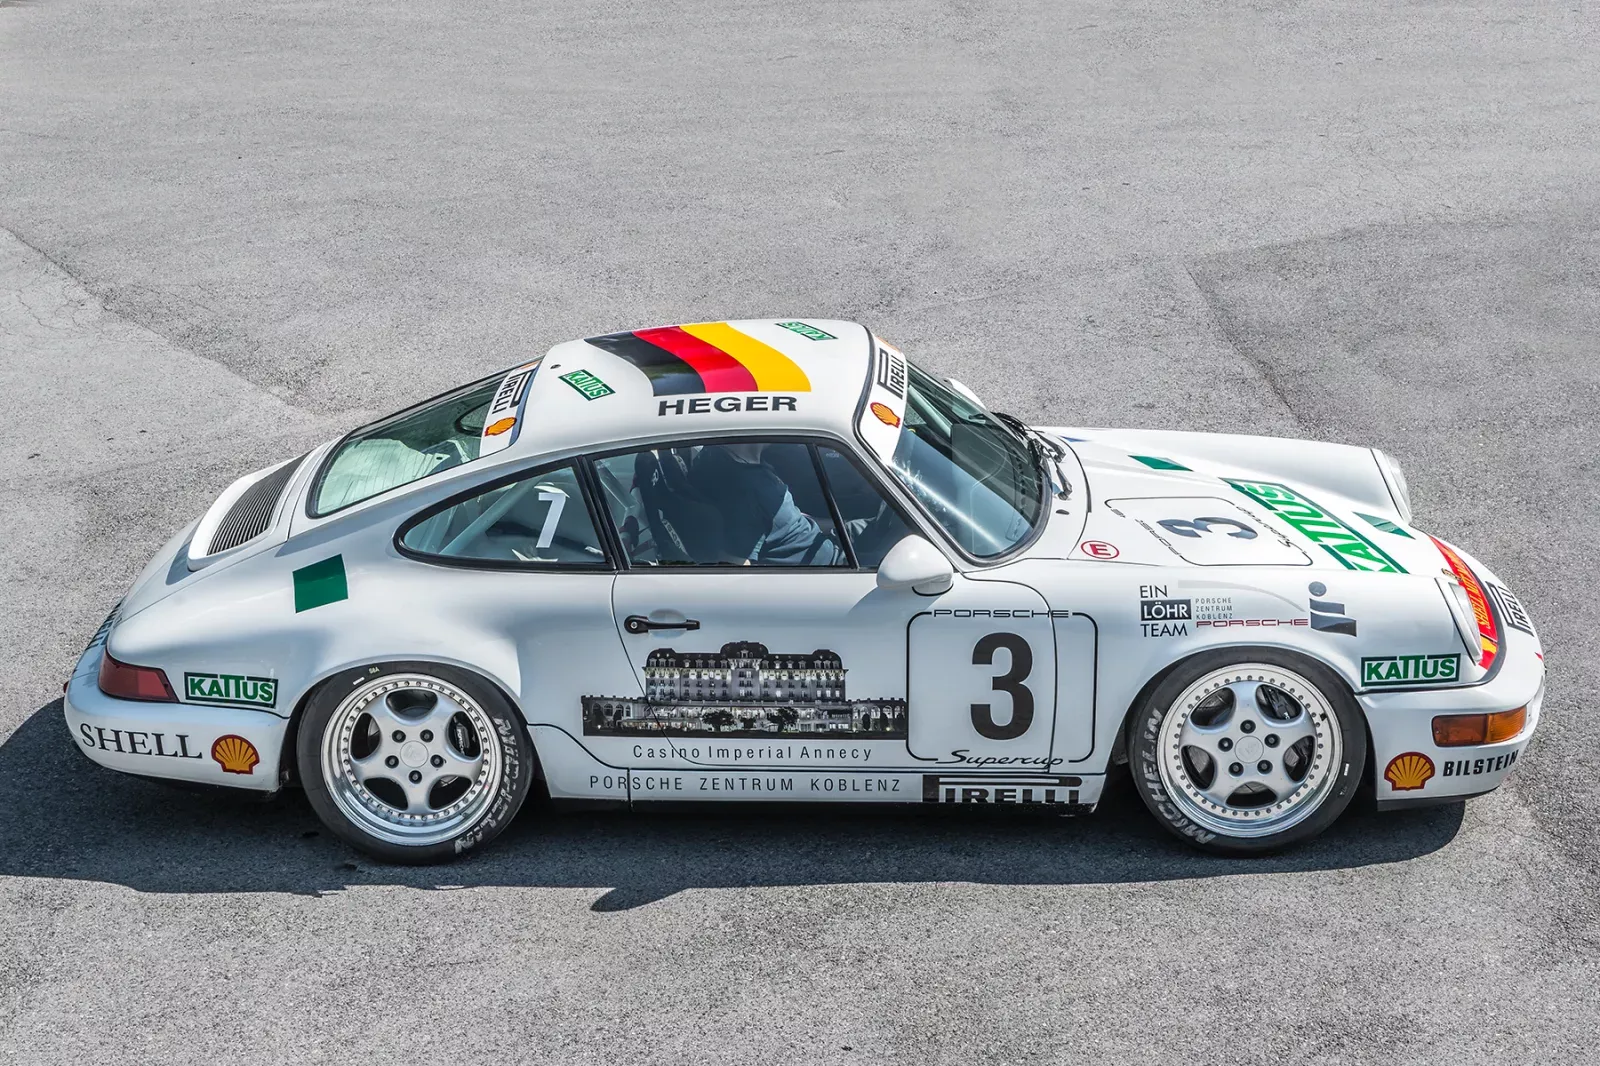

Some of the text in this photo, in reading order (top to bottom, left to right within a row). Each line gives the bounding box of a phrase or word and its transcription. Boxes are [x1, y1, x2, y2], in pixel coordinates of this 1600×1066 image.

[562, 371, 610, 398] KATTUS
[877, 347, 905, 400] PIRELLI
[491, 368, 536, 414] PIRELLI
[658, 396, 798, 417] HEGER
[1156, 516, 1258, 540] 3
[1088, 543, 1112, 556] E
[1140, 585, 1168, 598] EIN
[933, 609, 1070, 618] PORSCHE
[1143, 601, 1189, 619] LÖHR
[1195, 612, 1233, 620] KOBLENZ
[1484, 580, 1535, 637] PIRELLI
[1140, 623, 1188, 638] TEAM
[1196, 618, 1309, 629] PORSCHE
[1366, 654, 1456, 681] KATTUS
[189, 674, 274, 702] KATTUS
[970, 632, 1035, 741] 3
[80, 722, 203, 760] SHELL
[633, 745, 872, 761] Casino Imperial Annecy
[935, 749, 1064, 769] Supercup
[1442, 749, 1519, 777] BILSTEIN
[590, 776, 900, 792] PORSCHE ZENTRUM KOBLENZ
[922, 774, 1082, 804] PIRELLI
